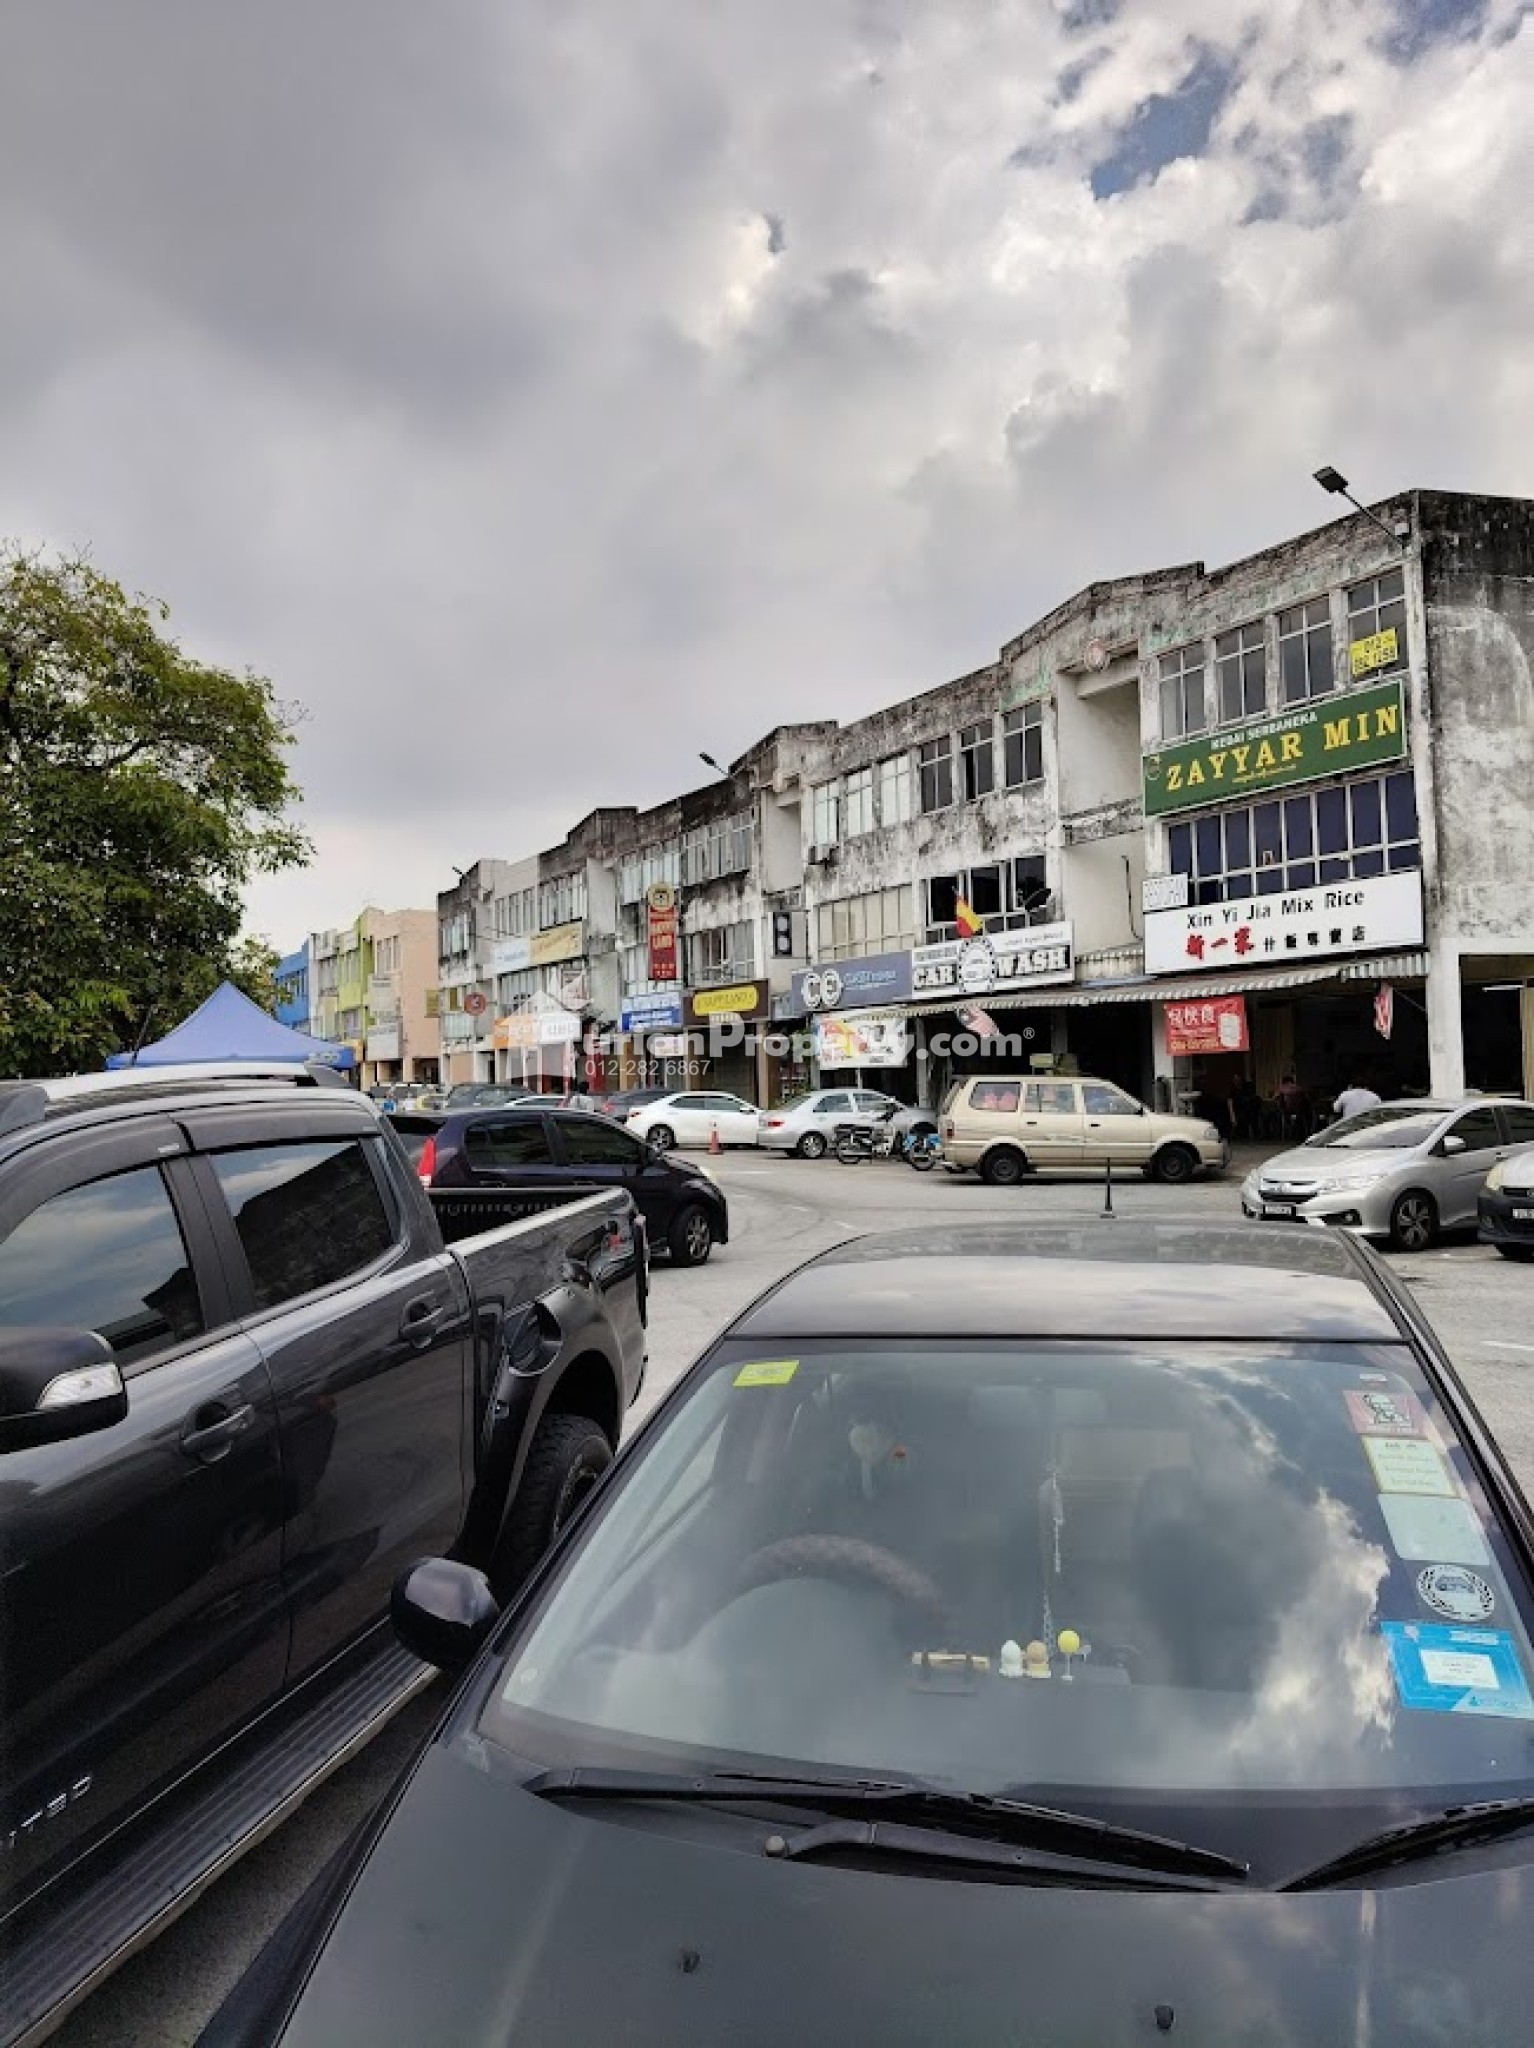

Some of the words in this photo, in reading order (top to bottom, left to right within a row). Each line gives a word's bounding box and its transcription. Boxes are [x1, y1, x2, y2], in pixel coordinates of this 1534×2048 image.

[1166, 732, 1304, 791] ZAYYAR
[1322, 704, 1398, 750] MIN
[1187, 912, 1212, 929] Xin
[1222, 907, 1238, 924] Yi
[1246, 902, 1271, 920] Jia
[1281, 897, 1314, 915] Mix
[1323, 890, 1366, 910] Rice
[913, 965, 956, 990] CAR
[997, 945, 1069, 978] WASH
